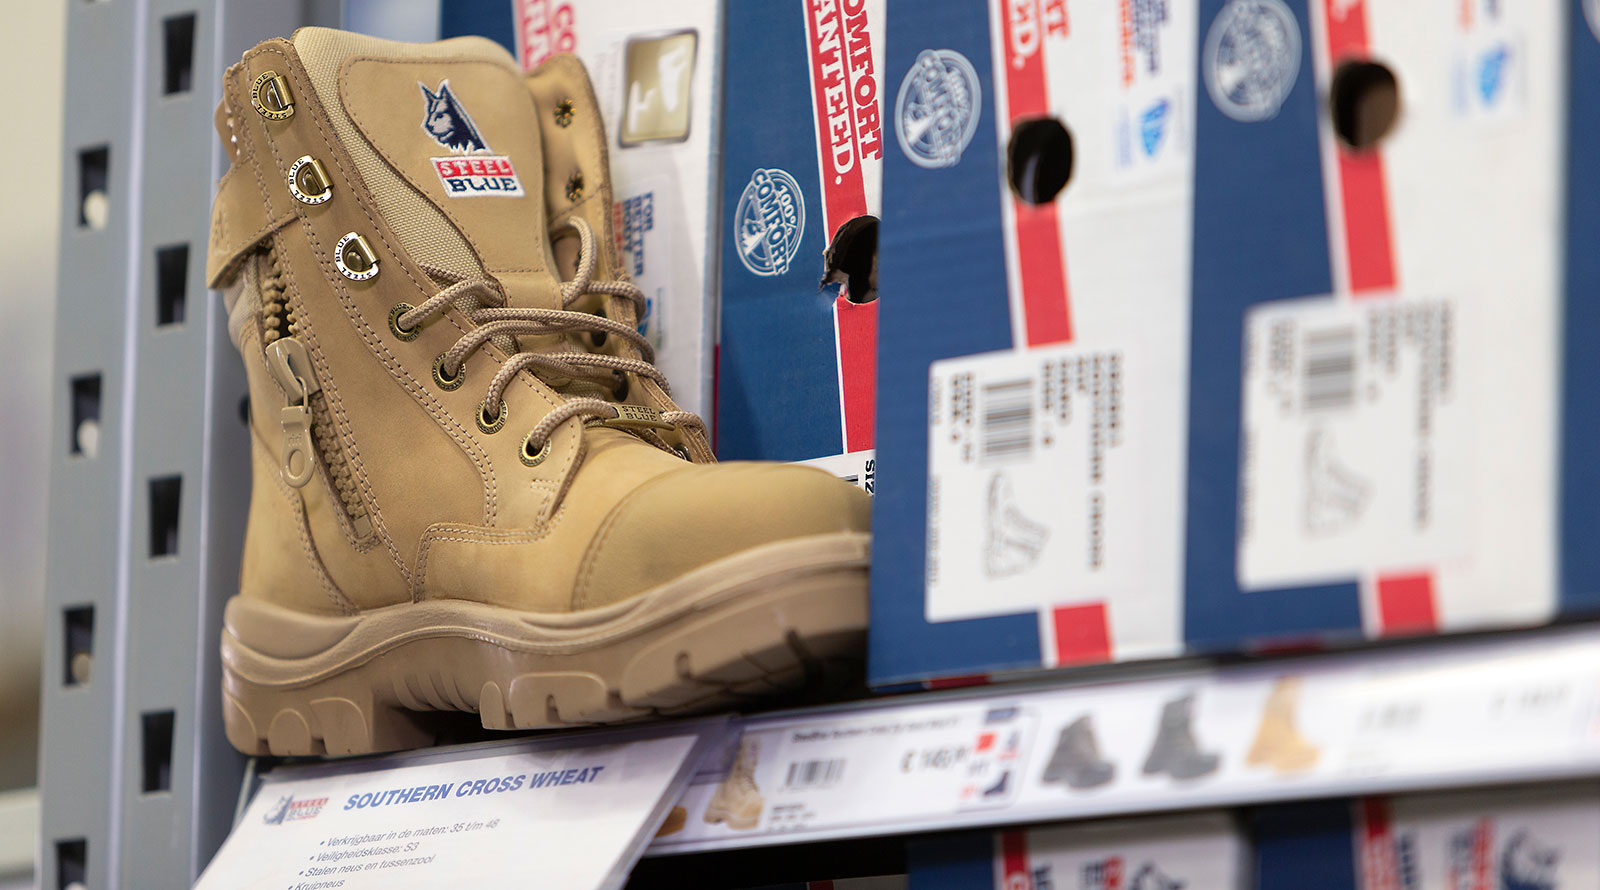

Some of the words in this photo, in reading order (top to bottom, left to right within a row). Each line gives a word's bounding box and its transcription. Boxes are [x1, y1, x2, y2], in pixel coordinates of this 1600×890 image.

[289, 158, 305, 185] BLUE
[438, 160, 511, 176] STEEL
[294, 189, 326, 204] STEEL
[446, 177, 518, 193] BLUE
[752, 168, 789, 276] COMFORT
[778, 184, 797, 237] 100%
[335, 235, 350, 262] BLUE
[341, 266, 375, 279] STEEL
[621, 405, 656, 415] STEEL
[625, 412, 658, 422] BLUE
[865, 459, 876, 496] SIZ
[343, 783, 454, 811] SOUTHERN
[455, 774, 527, 798] CROSS
[529, 766, 605, 789] WHEAT
[327, 832, 387, 847] Verkrijgbaar
[386, 830, 397, 841] in
[398, 829, 413, 840] de
[412, 826, 449, 838] maten:
[449, 822, 465, 833] 35
[464, 820, 484, 831] t/m
[316, 845, 403, 863] Veiligheidsklasse:
[403, 841, 420, 853] S3
[304, 865, 338, 878] Stalen
[339, 863, 362, 874] neus
[364, 861, 378, 871] en
[378, 854, 437, 870] tussenzool
